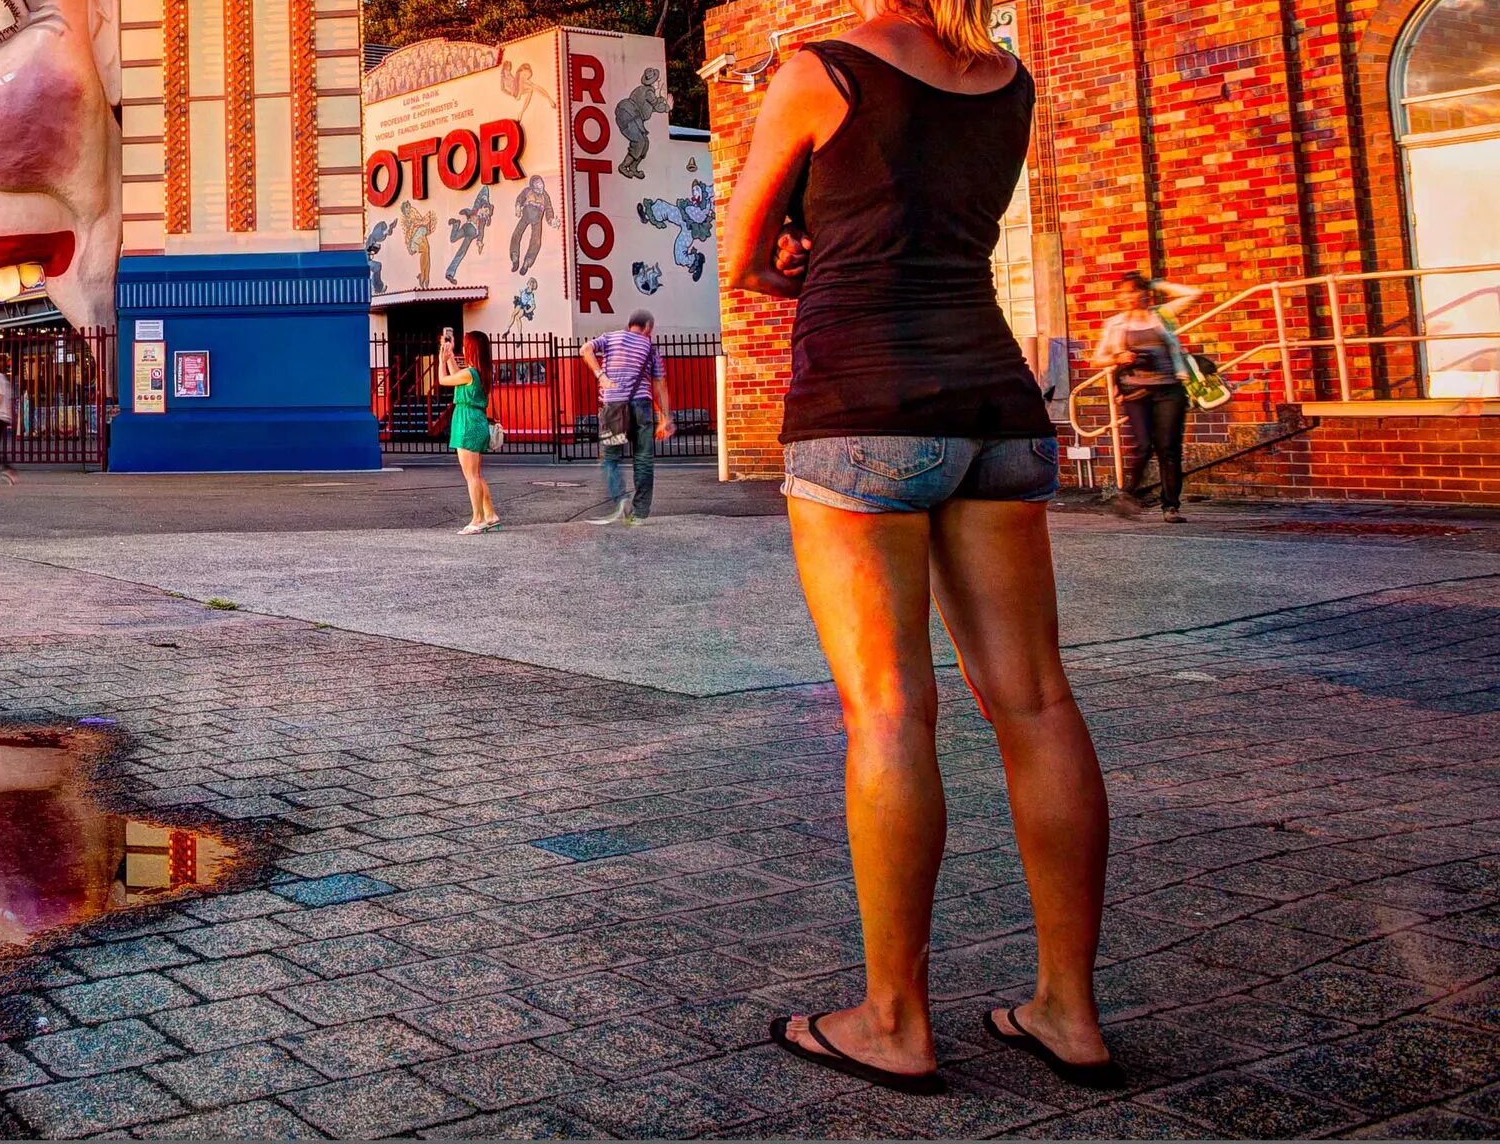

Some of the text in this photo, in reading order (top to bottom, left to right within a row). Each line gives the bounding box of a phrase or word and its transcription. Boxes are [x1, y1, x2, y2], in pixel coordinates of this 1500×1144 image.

[403, 89, 439, 106] LUNA PARK
[375, 108, 475, 141] WORLD FAMOUS SCIENTIFIC THEATRE
[380, 114, 410, 128] PROFESSOR
[366, 118, 526, 208] OTOR
[570, 53, 614, 314] ROTOR
